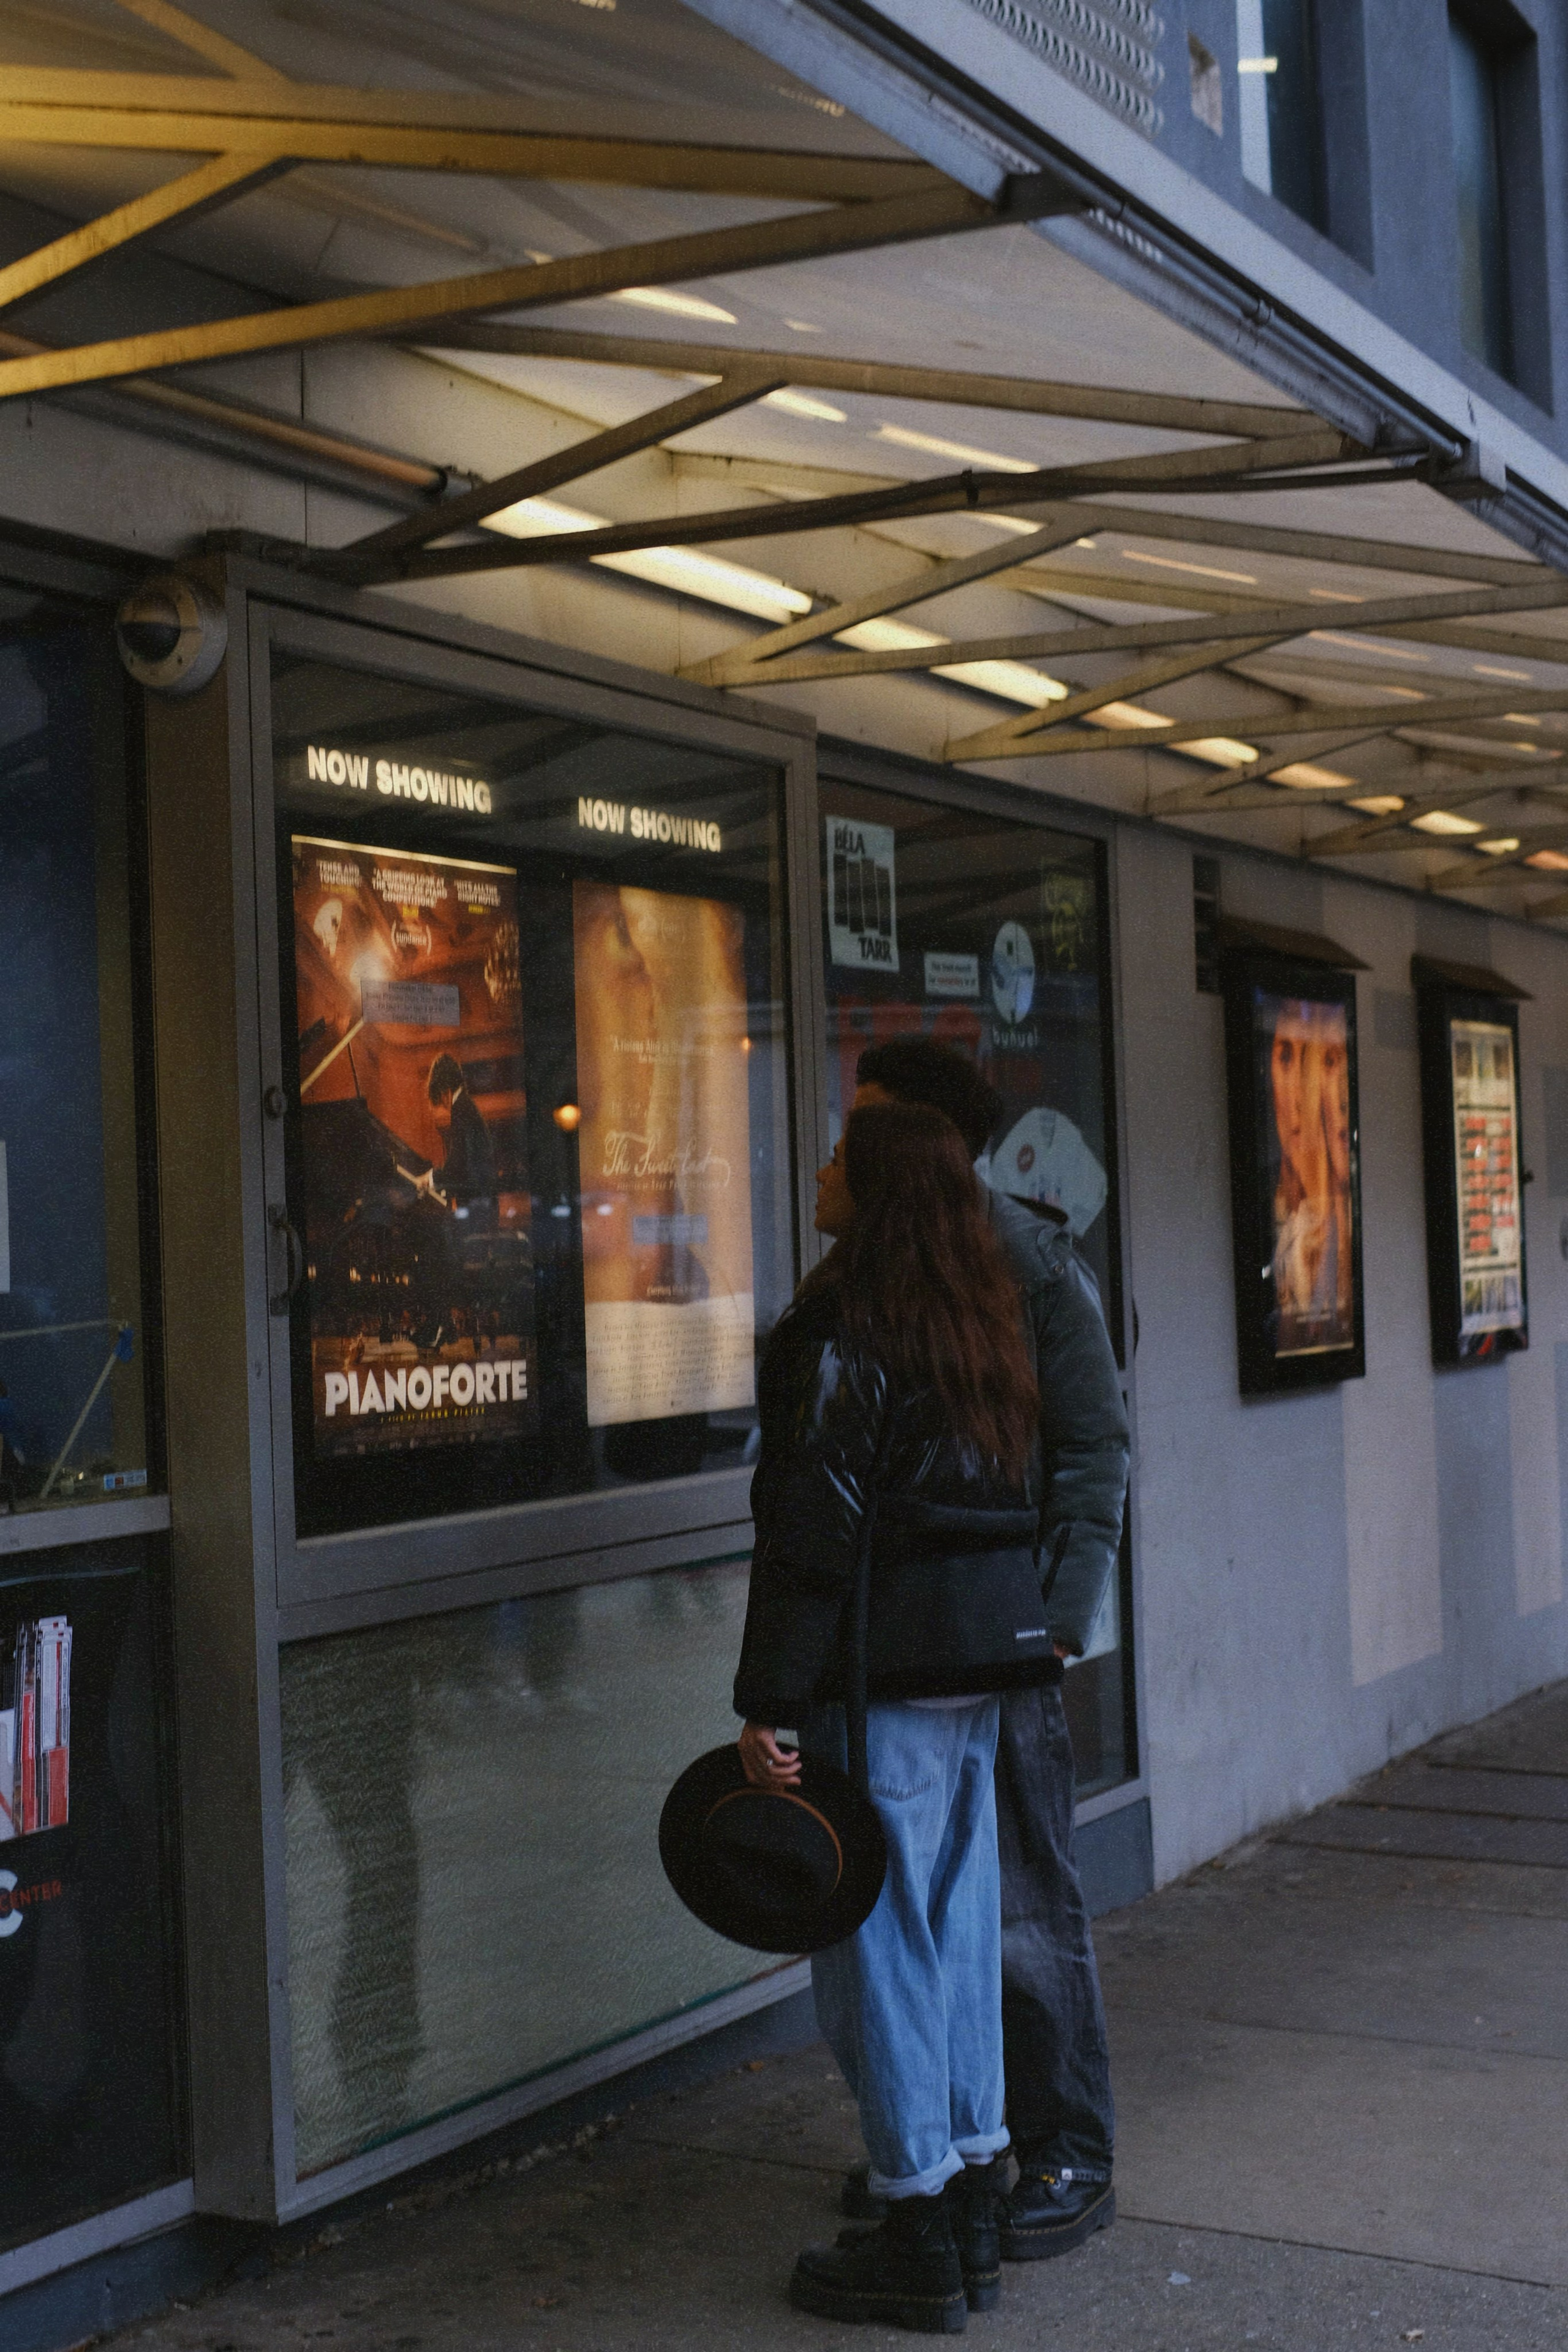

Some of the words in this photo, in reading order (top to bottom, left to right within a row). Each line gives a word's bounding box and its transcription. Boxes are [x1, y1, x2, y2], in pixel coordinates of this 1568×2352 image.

[307, 745, 369, 790] NOW
[375, 759, 492, 814] SHOWING
[578, 796, 625, 835] NOW
[630, 806, 722, 853] SHOWING
[858, 937, 892, 963] TARR
[324, 1359, 529, 1417] PIANOFORTE
